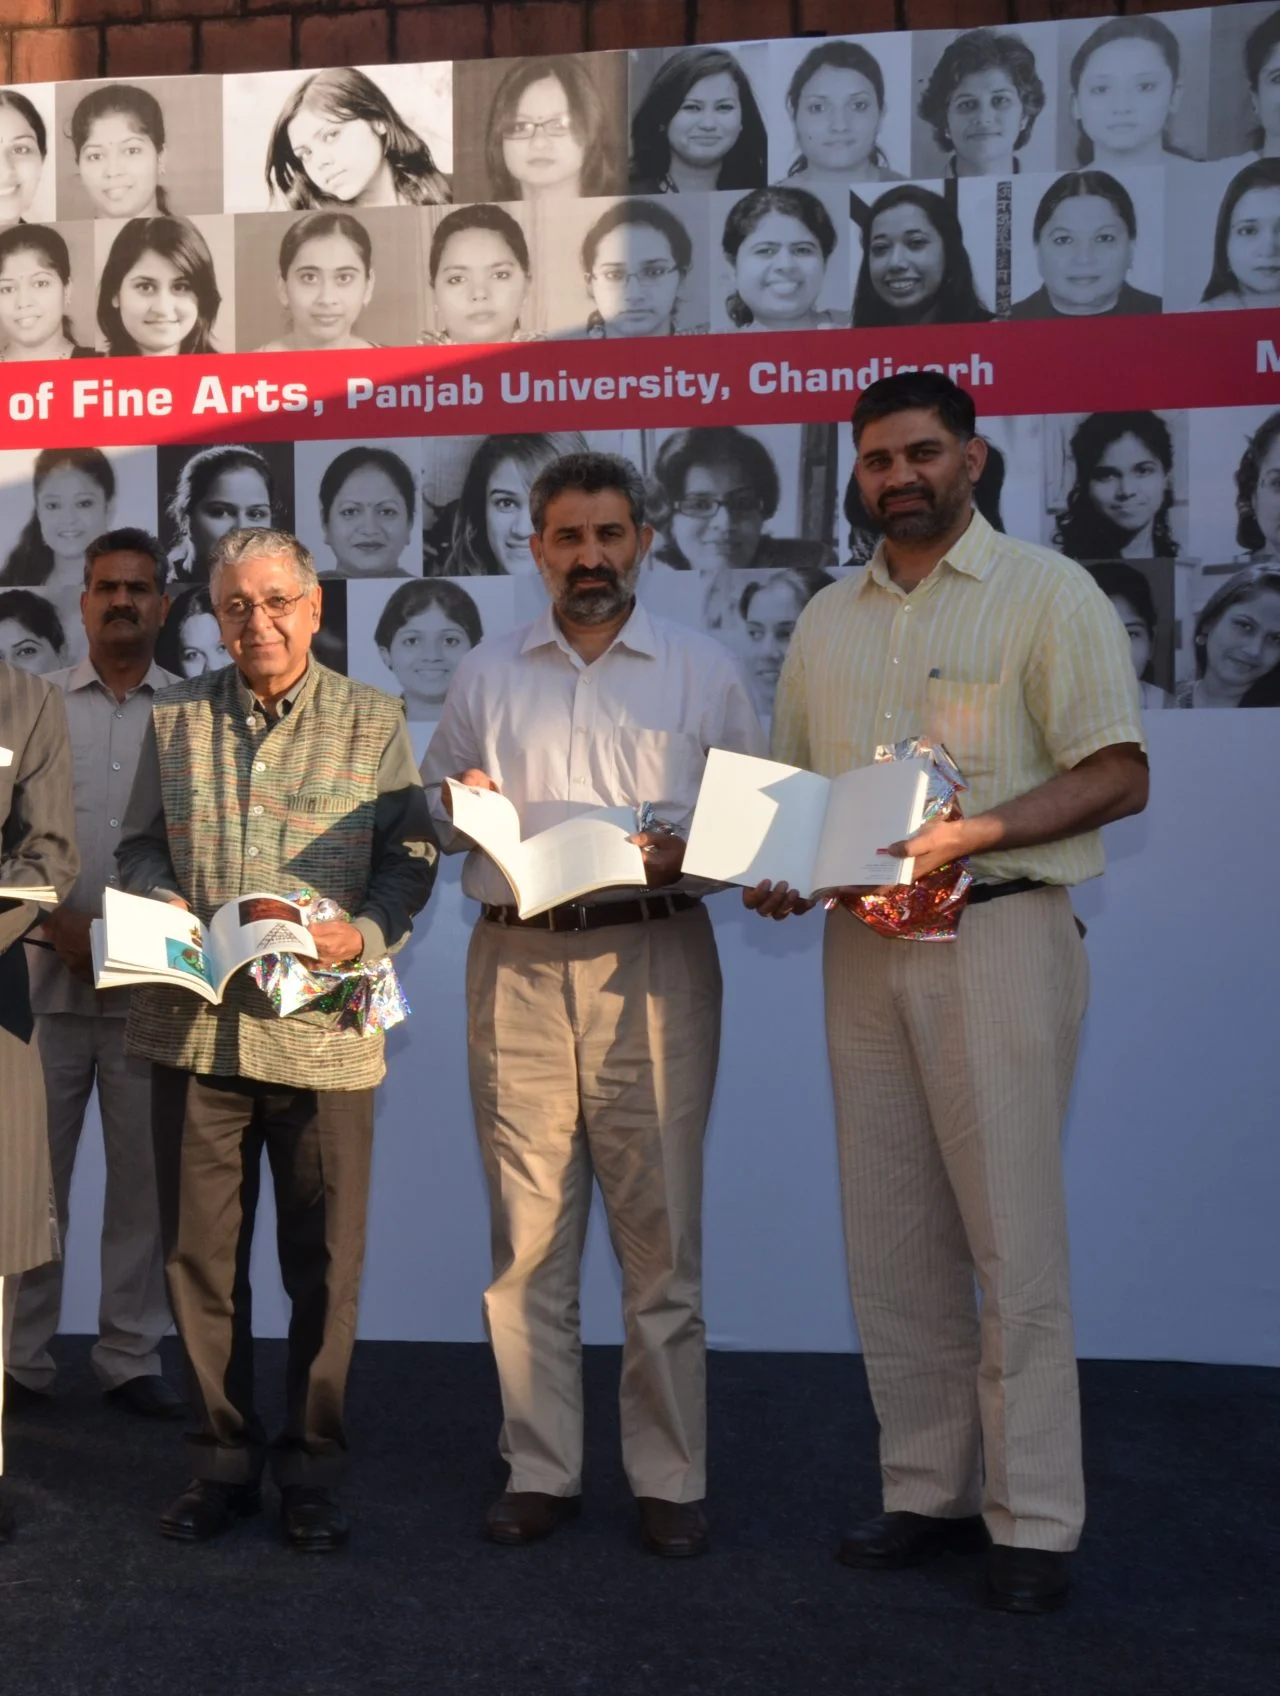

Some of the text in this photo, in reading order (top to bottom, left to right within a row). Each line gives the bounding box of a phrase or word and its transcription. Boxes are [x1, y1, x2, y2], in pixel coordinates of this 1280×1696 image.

[9, 381, 54, 421] of
[72, 379, 173, 419] Fine
[191, 375, 324, 418] Arts,
[346, 373, 484, 413] Panjab
[500, 365, 730, 403] University,
[749, 353, 994, 394] Chandirh
